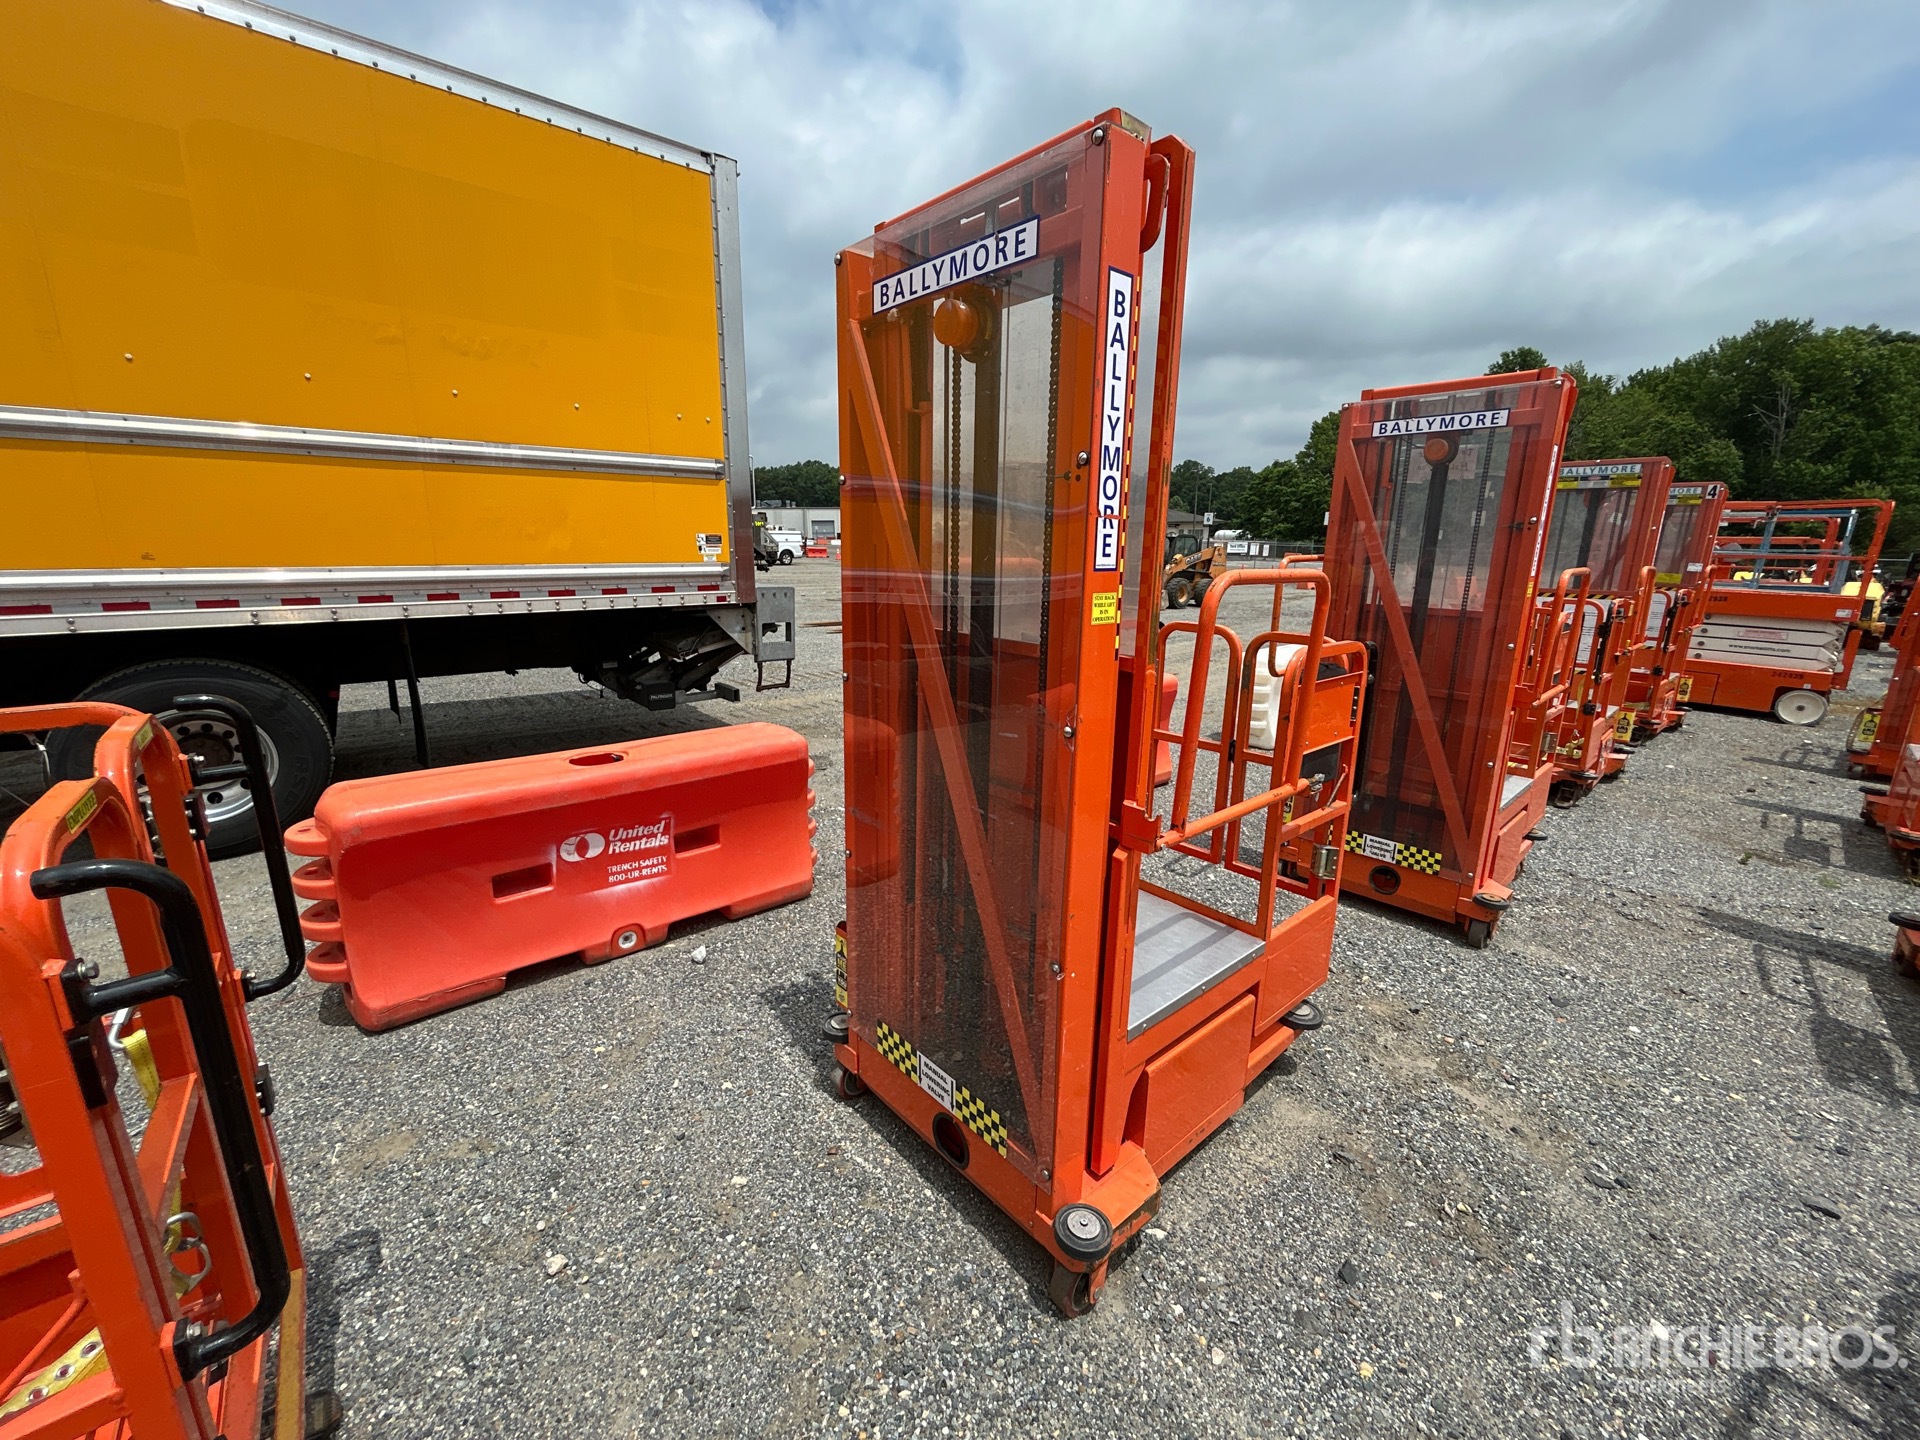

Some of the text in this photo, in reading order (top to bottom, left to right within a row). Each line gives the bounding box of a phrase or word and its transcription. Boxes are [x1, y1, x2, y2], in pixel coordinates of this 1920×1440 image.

[880, 227, 1027, 308] BALLYMORE
[1102, 289, 1126, 558] BALLYMORE
[1378, 412, 1501, 434] BALLYMORE
[1707, 484, 1718, 499] 4
[608, 820, 664, 841] United
[608, 833, 669, 855] Rentals
[1369, 838, 1391, 847] MANUAL
[607, 855, 668, 874] TRENCH SAFETY
[608, 865, 668, 883] 800-UR-RENTS
[921, 1068, 951, 1097] LOWERING
[923, 1060, 948, 1085] MANUAL
[927, 1083, 945, 1102] VALVE
